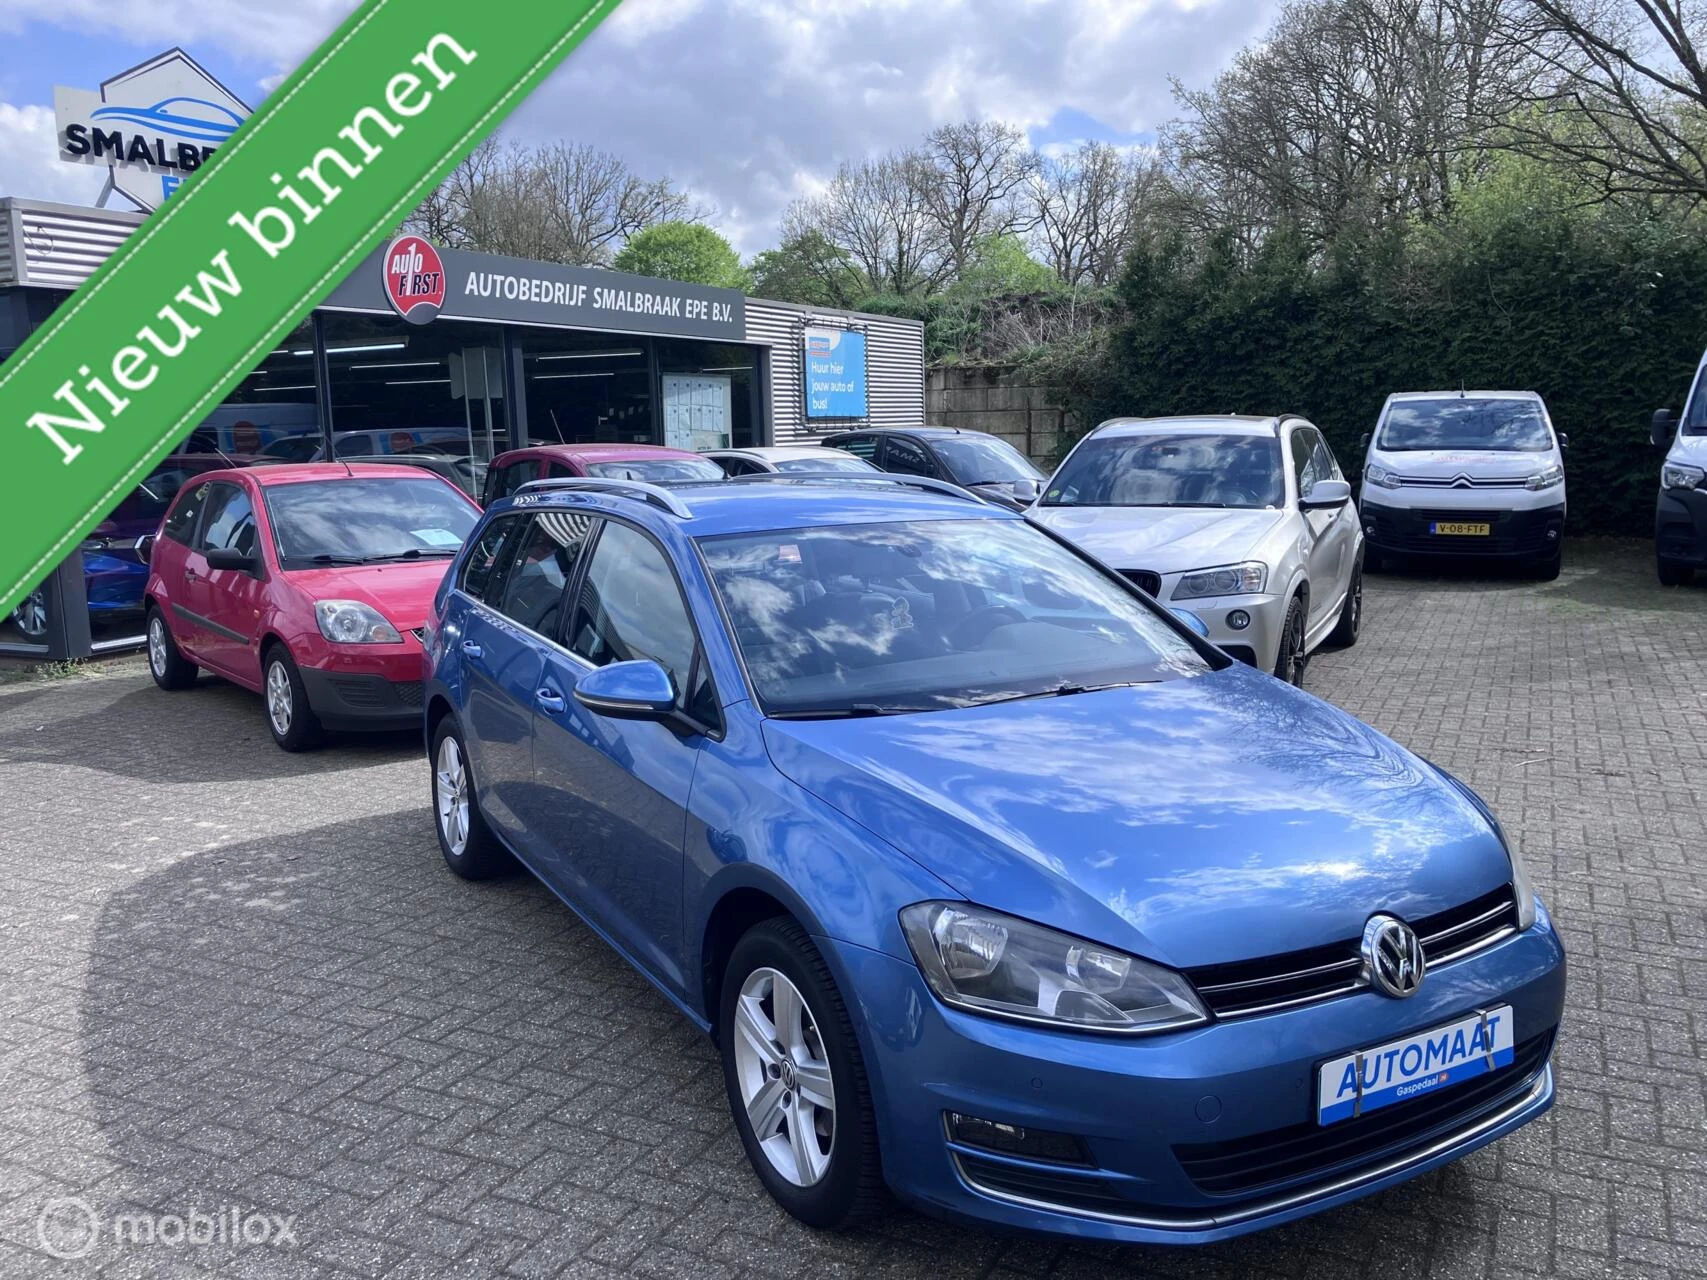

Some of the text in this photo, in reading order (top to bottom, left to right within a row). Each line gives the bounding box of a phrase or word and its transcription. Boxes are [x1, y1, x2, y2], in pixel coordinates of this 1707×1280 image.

[66, 123, 218, 172] SMALB
[465, 271, 733, 323] AUTOBEDRIJF SMALBRAAK EPE B.V.
[811, 361, 844, 375] Huur hier
[811, 379, 855, 394] jouw auto of
[1439, 524, 1486, 534] V-08-FTF
[1336, 1015, 1501, 1098] AUTOMAAT
[1396, 1074, 1439, 1097] Gaspedaal
